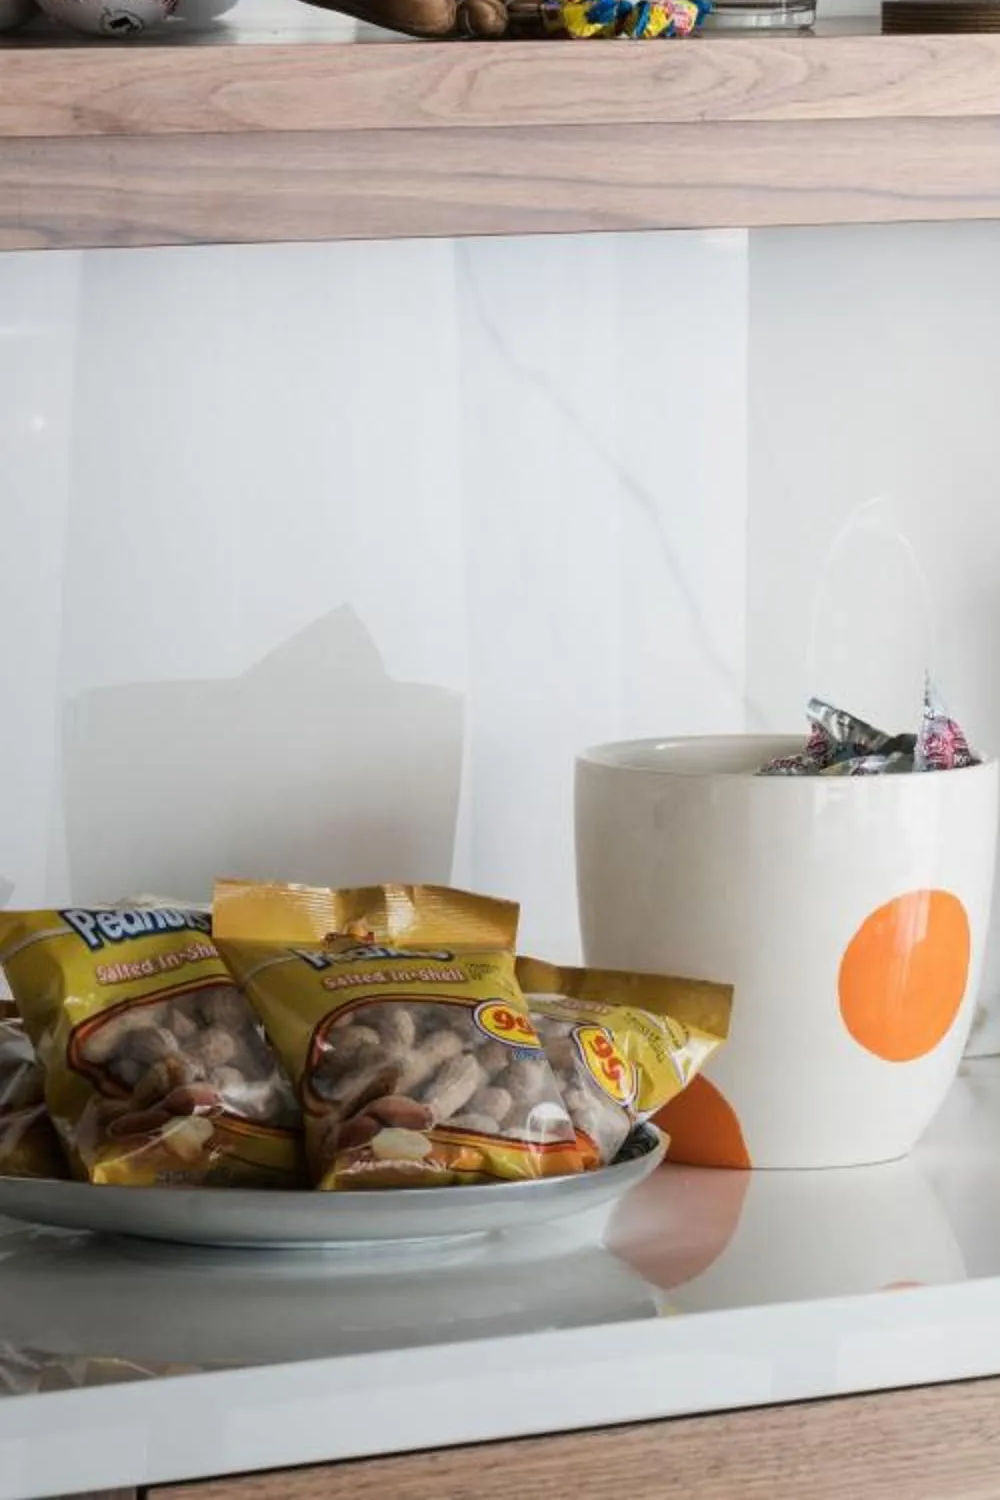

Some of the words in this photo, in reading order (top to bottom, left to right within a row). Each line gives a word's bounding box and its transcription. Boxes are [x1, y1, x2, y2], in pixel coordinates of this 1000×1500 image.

[97, 958, 154, 982] Salted
[159, 943, 220, 969] In-She
[323, 972, 387, 990] Salted
